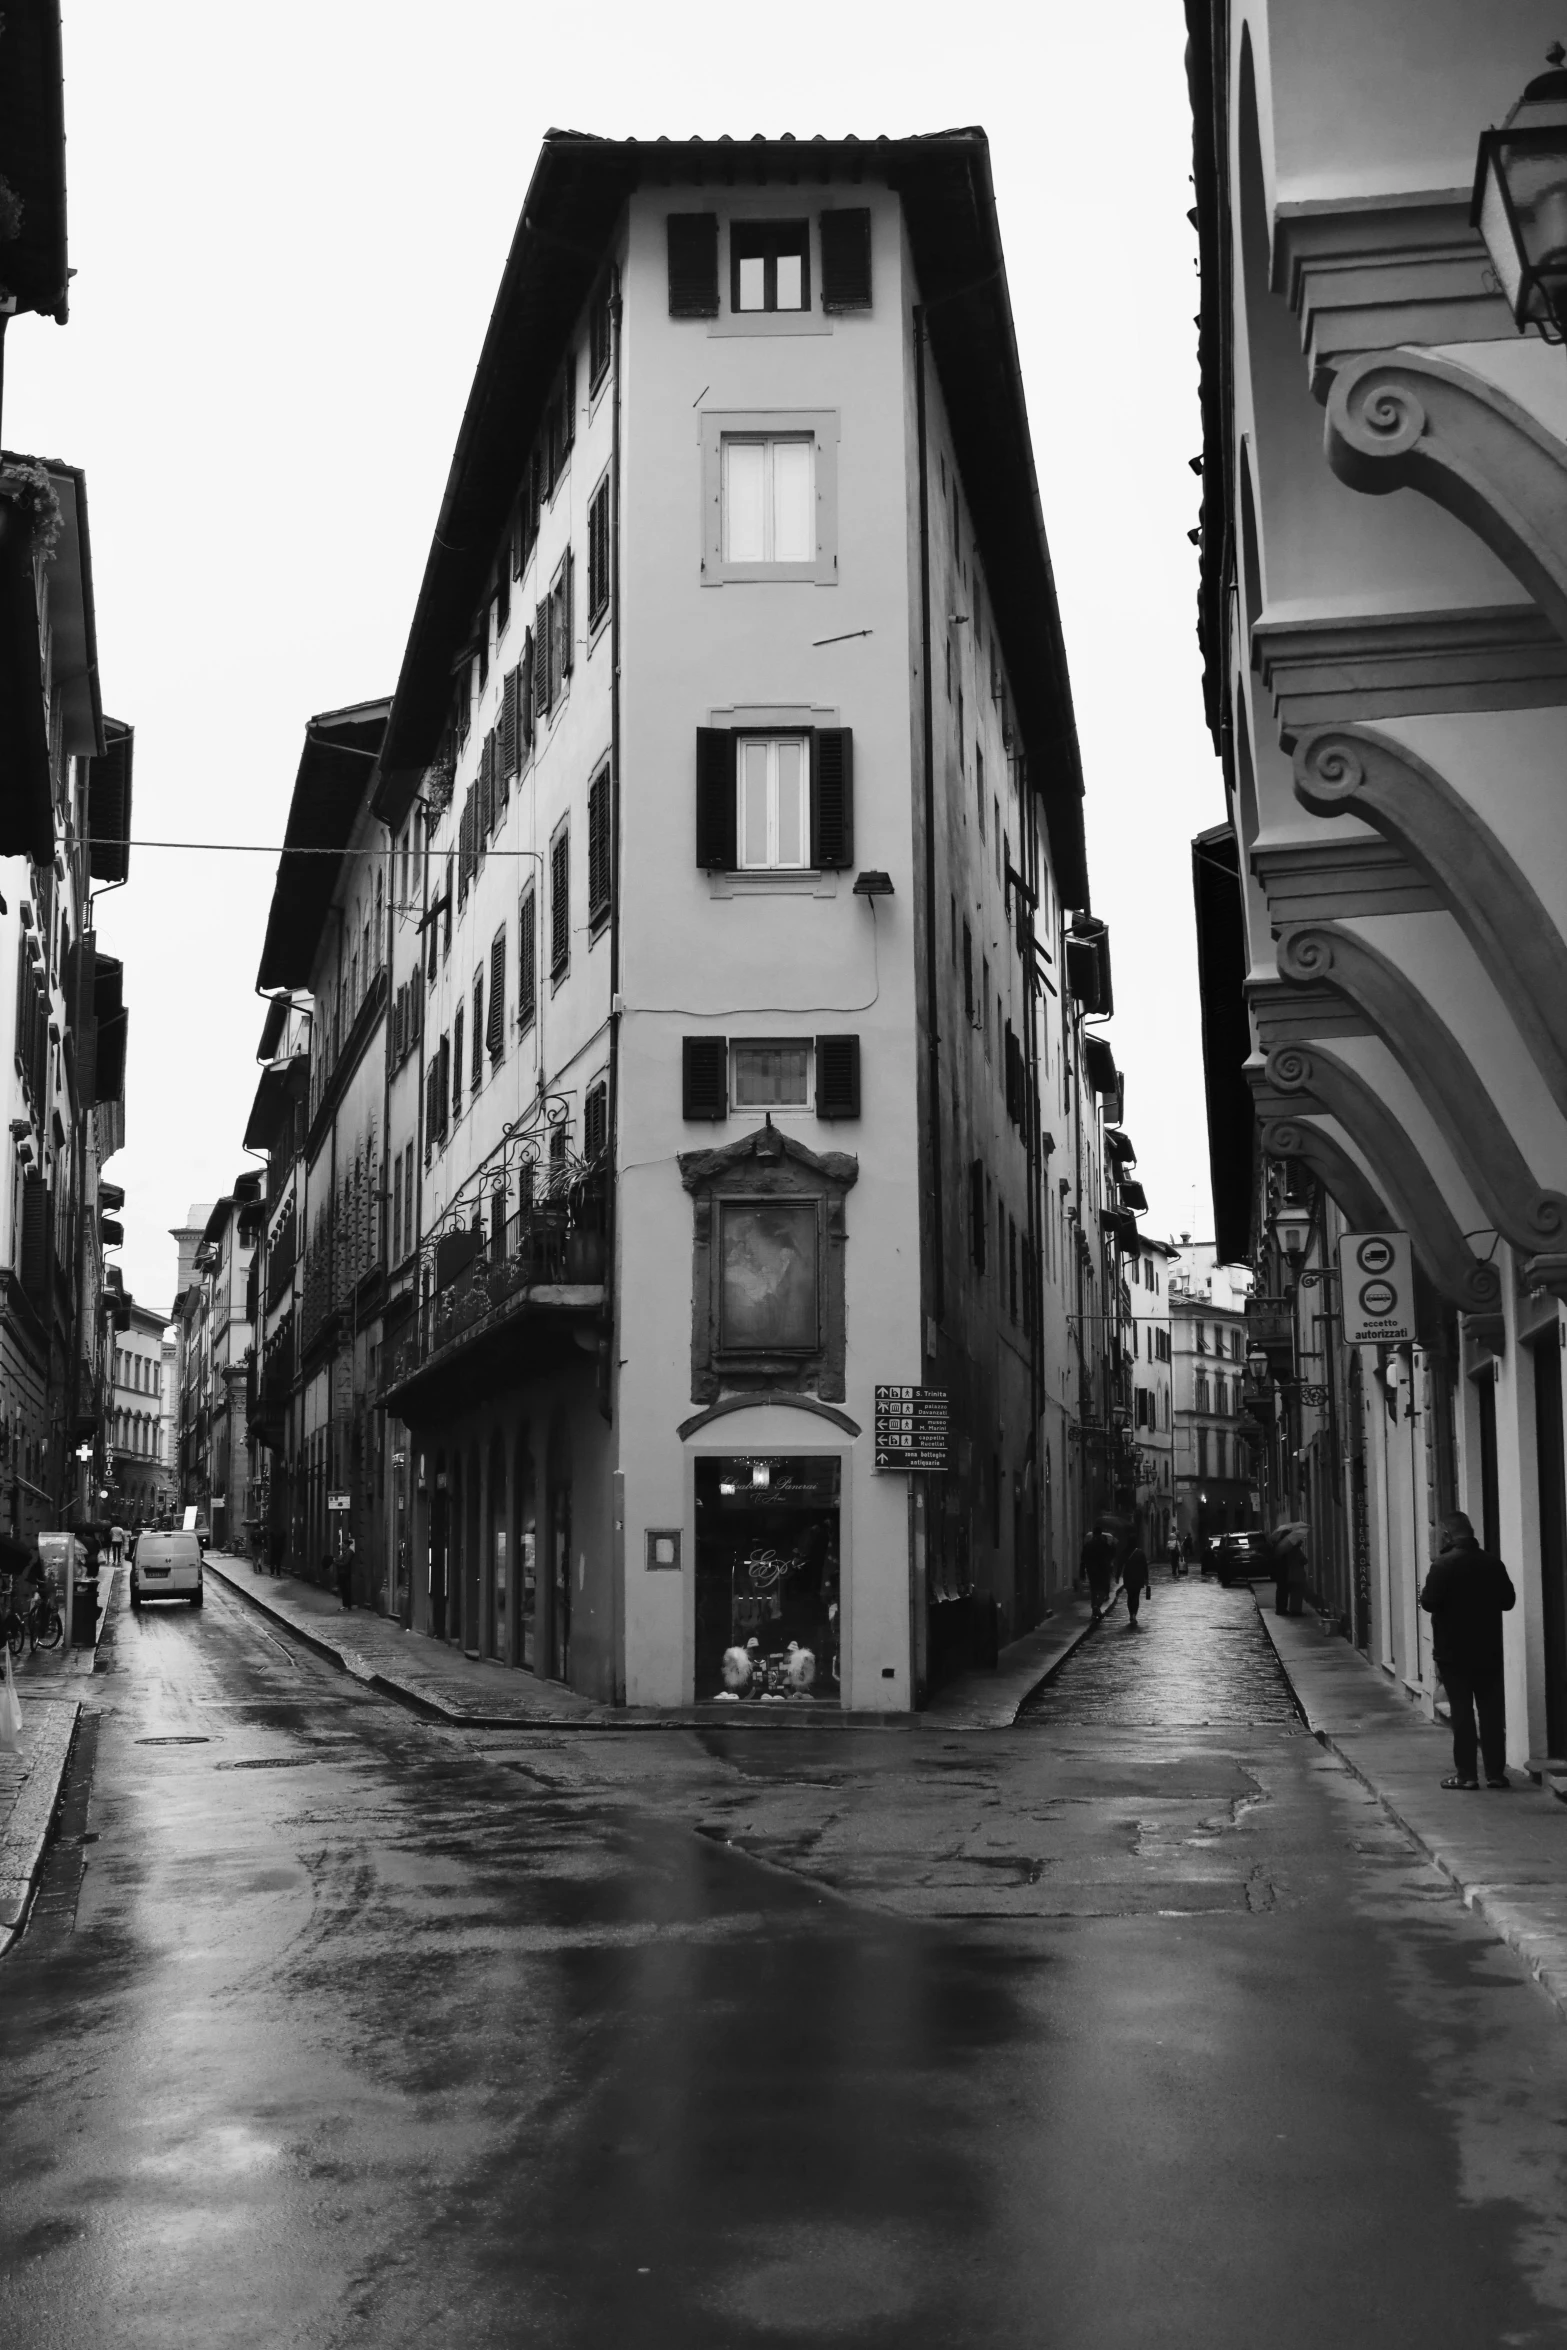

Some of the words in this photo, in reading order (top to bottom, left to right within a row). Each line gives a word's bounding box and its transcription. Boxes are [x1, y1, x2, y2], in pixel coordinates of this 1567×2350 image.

[1363, 1319, 1398, 1327] eccetto
[1355, 1328, 1408, 1340] autorizzati
[719, 1476, 769, 1490] Elsabetta
[774, 1476, 818, 1490] Panerai
[1357, 1493, 1366, 1551] BOTTEGA
[1360, 1558, 1368, 1599] ORAFA
